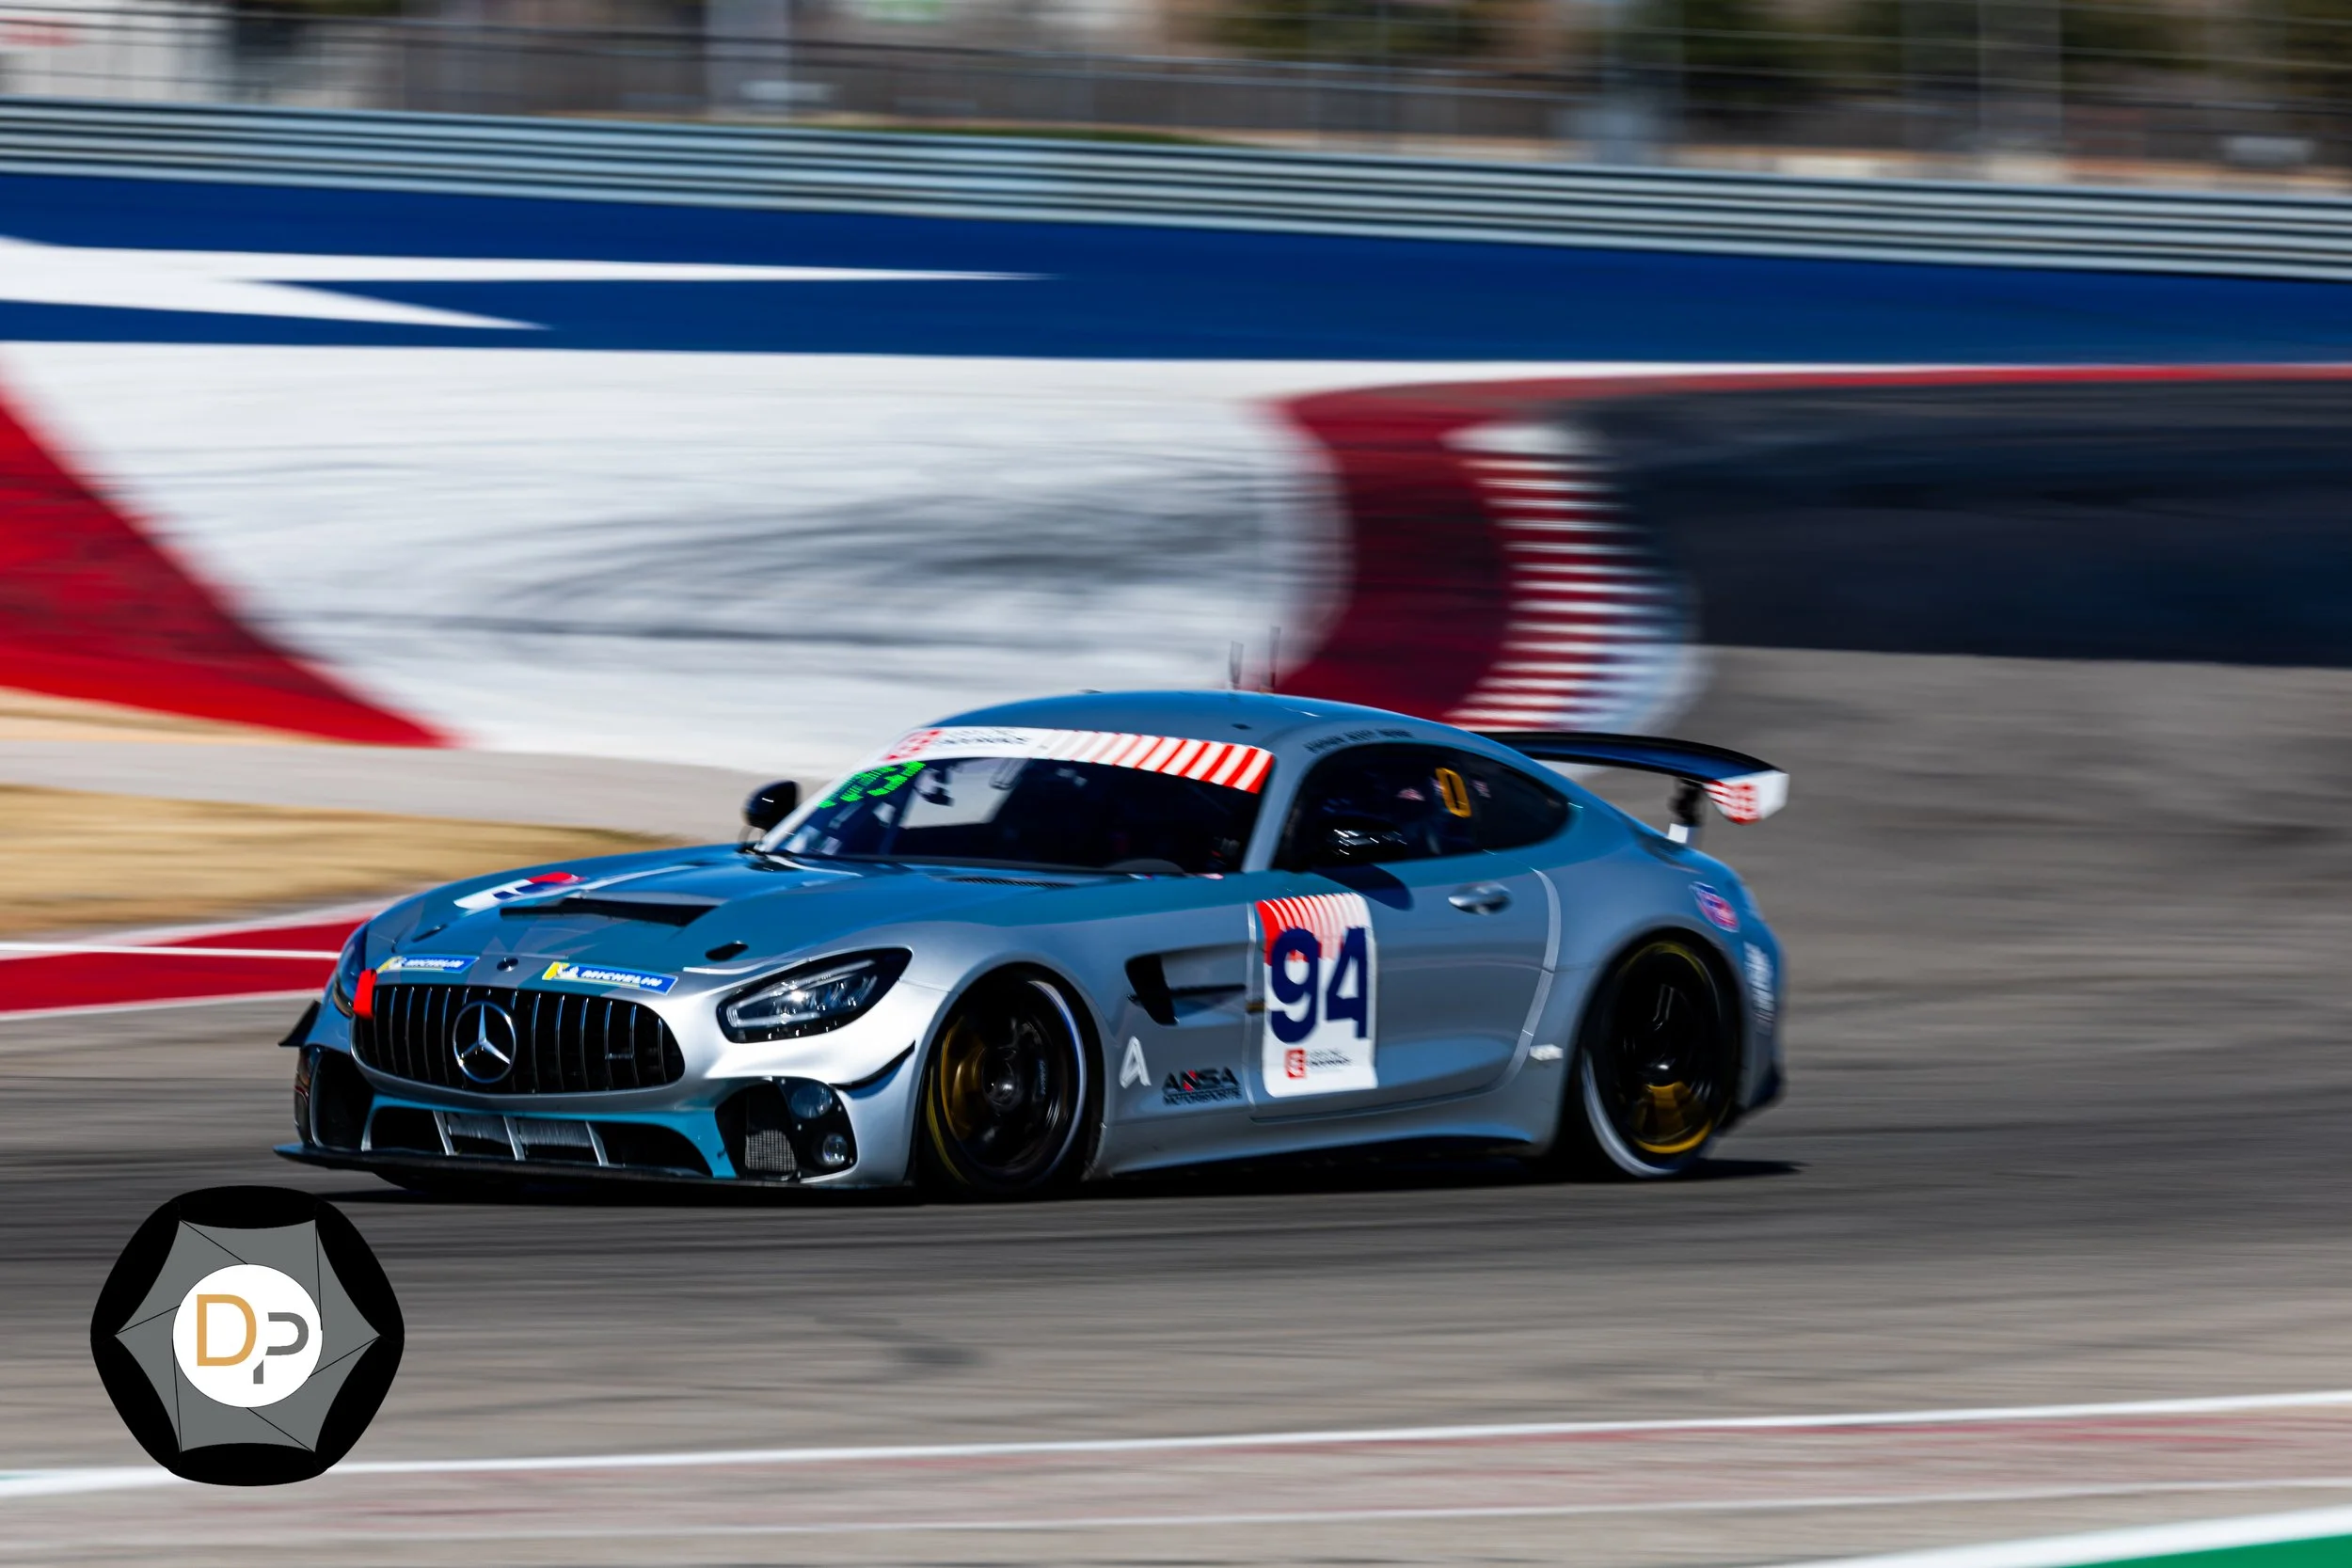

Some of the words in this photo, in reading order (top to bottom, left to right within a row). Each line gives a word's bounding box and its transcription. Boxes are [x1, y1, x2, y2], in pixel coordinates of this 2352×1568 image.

[405, 958, 465, 969] MICHELIN
[580, 969, 663, 988] MICHELIN
[1270, 926, 1368, 1044] 94
[1119, 1035, 1152, 1089] A
